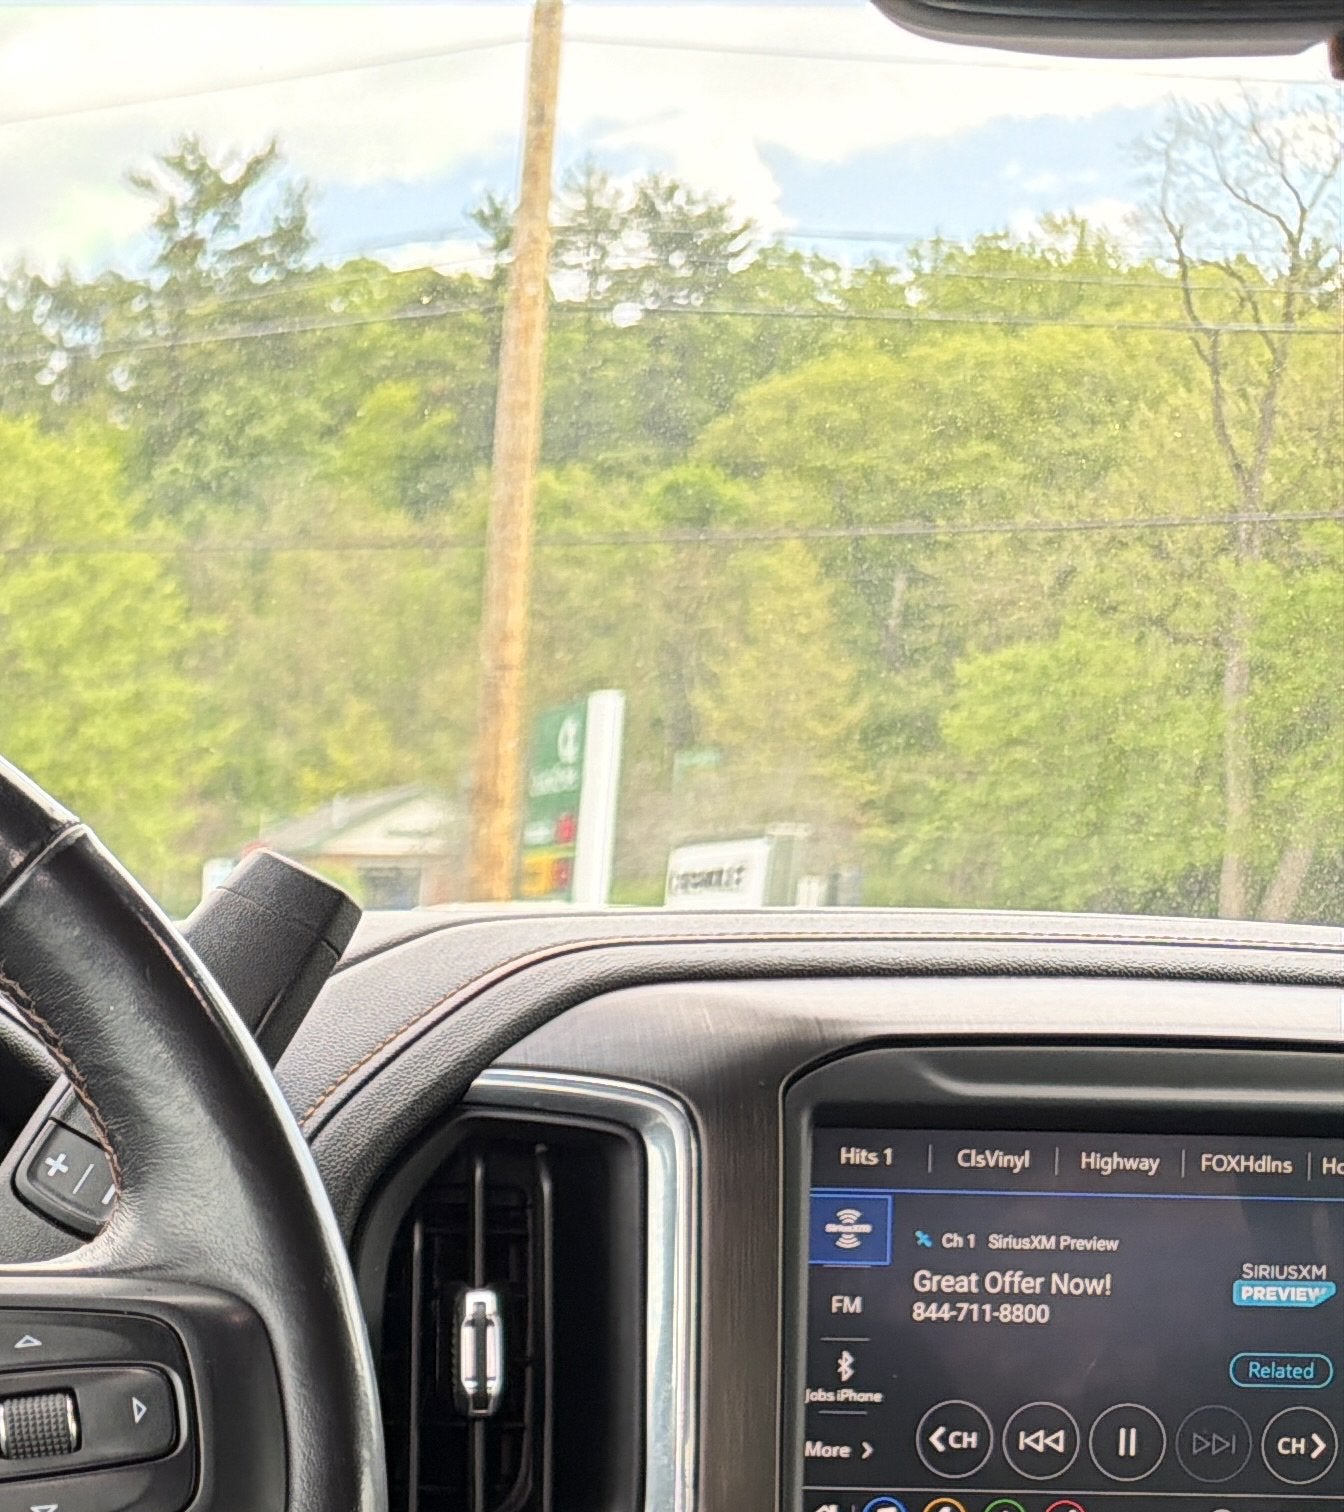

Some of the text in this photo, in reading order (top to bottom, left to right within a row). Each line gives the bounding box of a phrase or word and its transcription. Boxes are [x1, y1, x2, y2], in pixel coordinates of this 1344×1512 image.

[840, 1146, 893, 1165] Hits 1
[957, 1149, 1030, 1173] ClsVinyl
[1080, 1151, 1160, 1176] Highway
[1201, 1153, 1293, 1174] FOXHdlns
[941, 1232, 1119, 1251] Ch 1 SiriusXM Preview
[913, 1270, 1112, 1296] Great Offer Now!
[1241, 1286, 1328, 1302] PREVIEW
[831, 1295, 863, 1314] FM
[911, 1301, 1051, 1324] 844-711-8800
[1248, 1361, 1315, 1380] Related
[836, 1388, 883, 1403] iPhone
[804, 1440, 852, 1458] More
[948, 1430, 978, 1449] CH
[1277, 1437, 1306, 1455] CH
